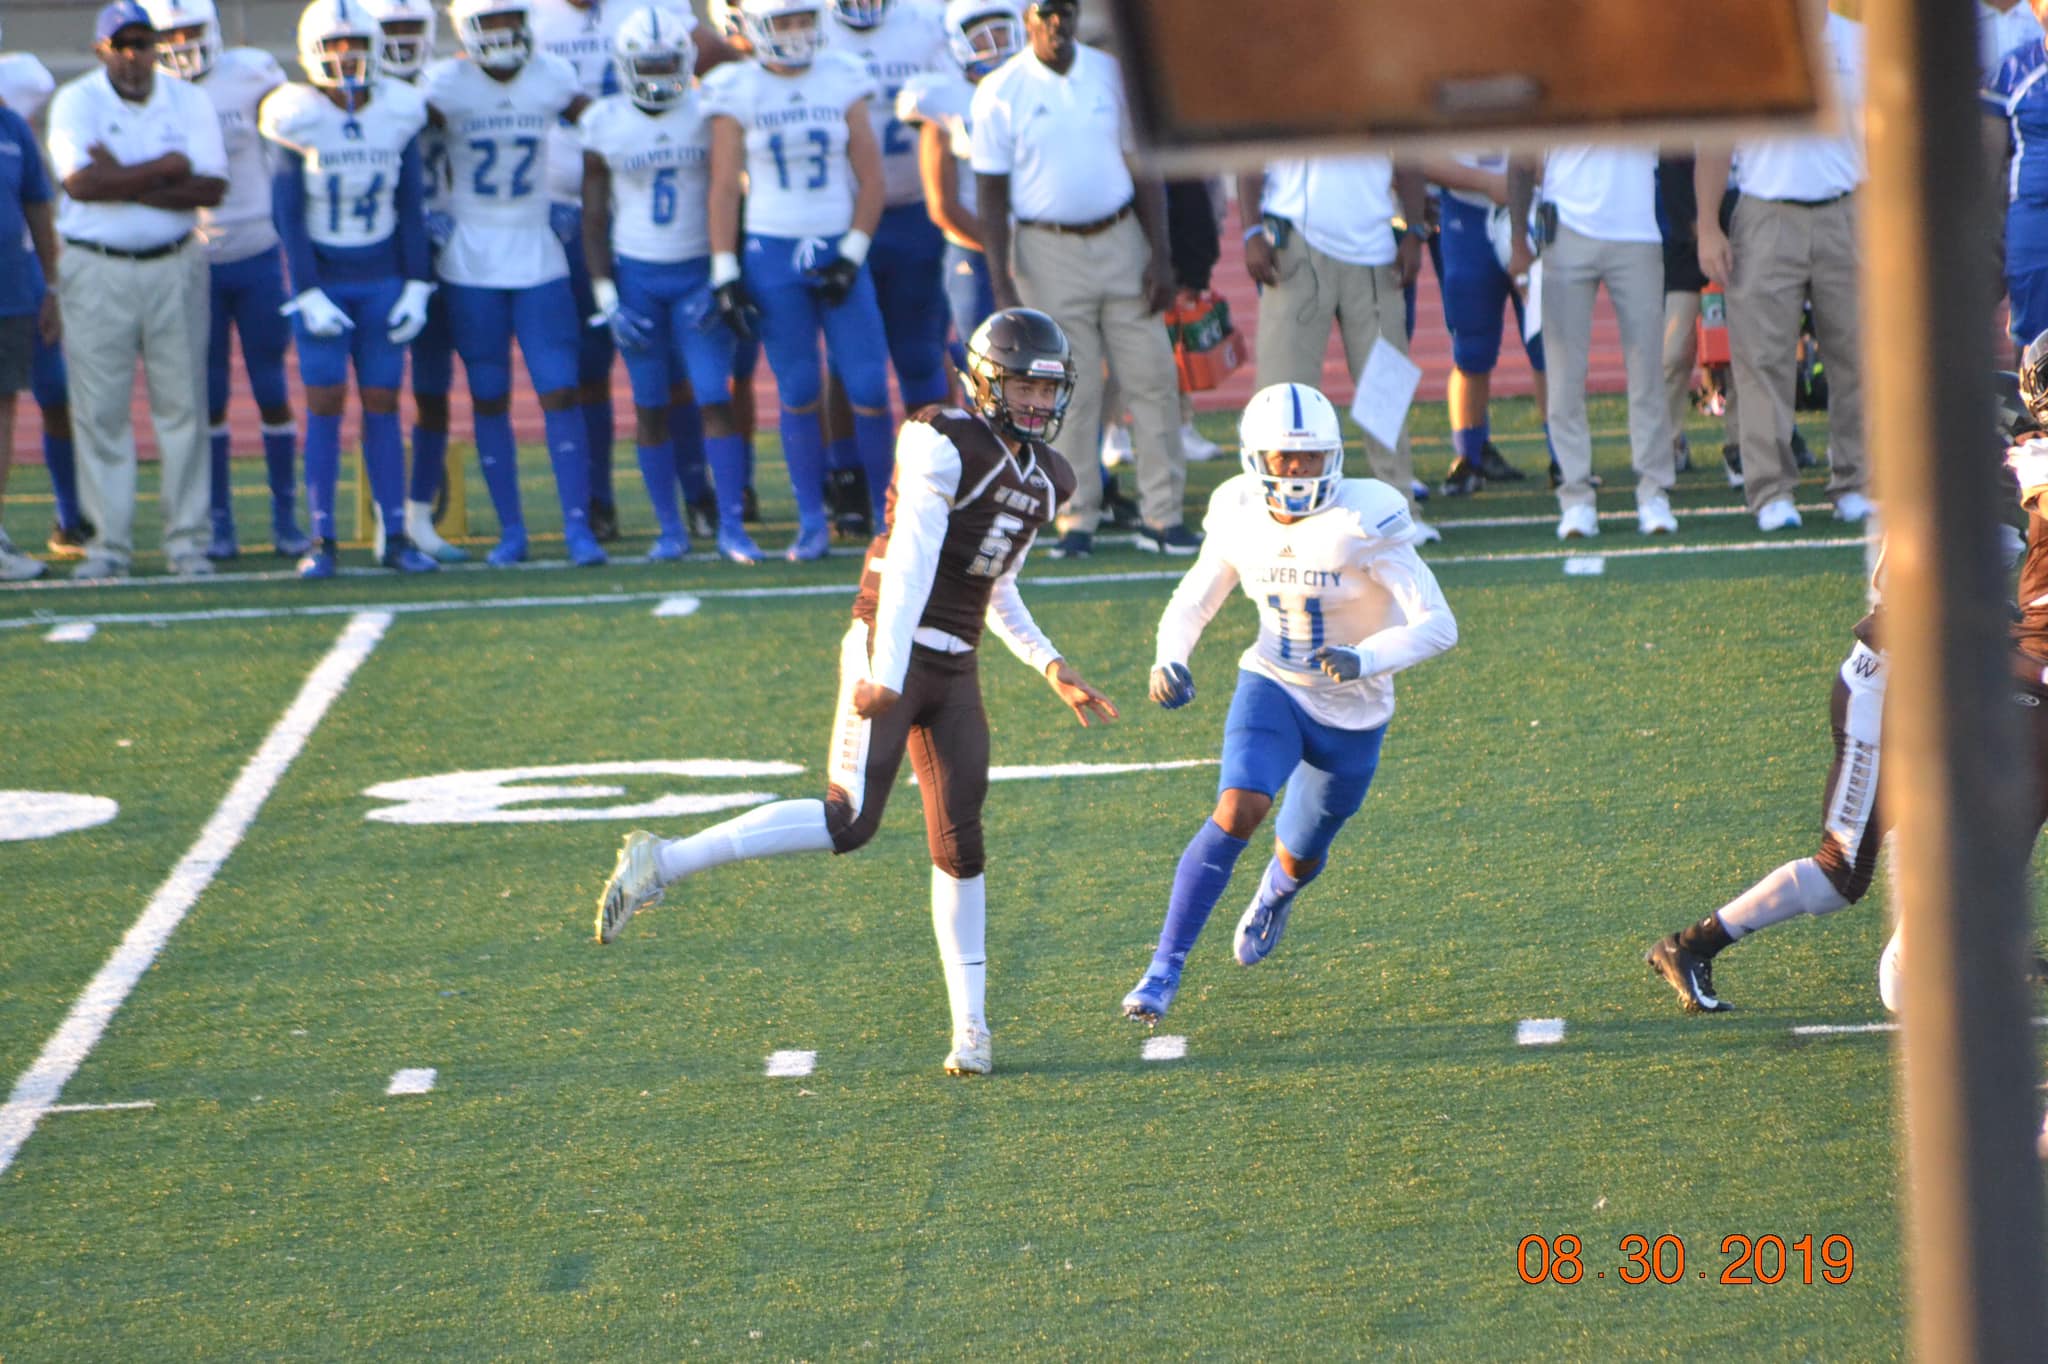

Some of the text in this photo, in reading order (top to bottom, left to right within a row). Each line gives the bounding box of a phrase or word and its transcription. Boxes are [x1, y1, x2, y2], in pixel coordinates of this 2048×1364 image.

[468, 135, 542, 198] 22
[768, 128, 831, 191] 13
[326, 171, 387, 235] 14
[652, 166, 678, 226] 6
[965, 511, 1024, 578] 5
[1303, 569, 1342, 588] CITY
[1266, 593, 1325, 669] 11
